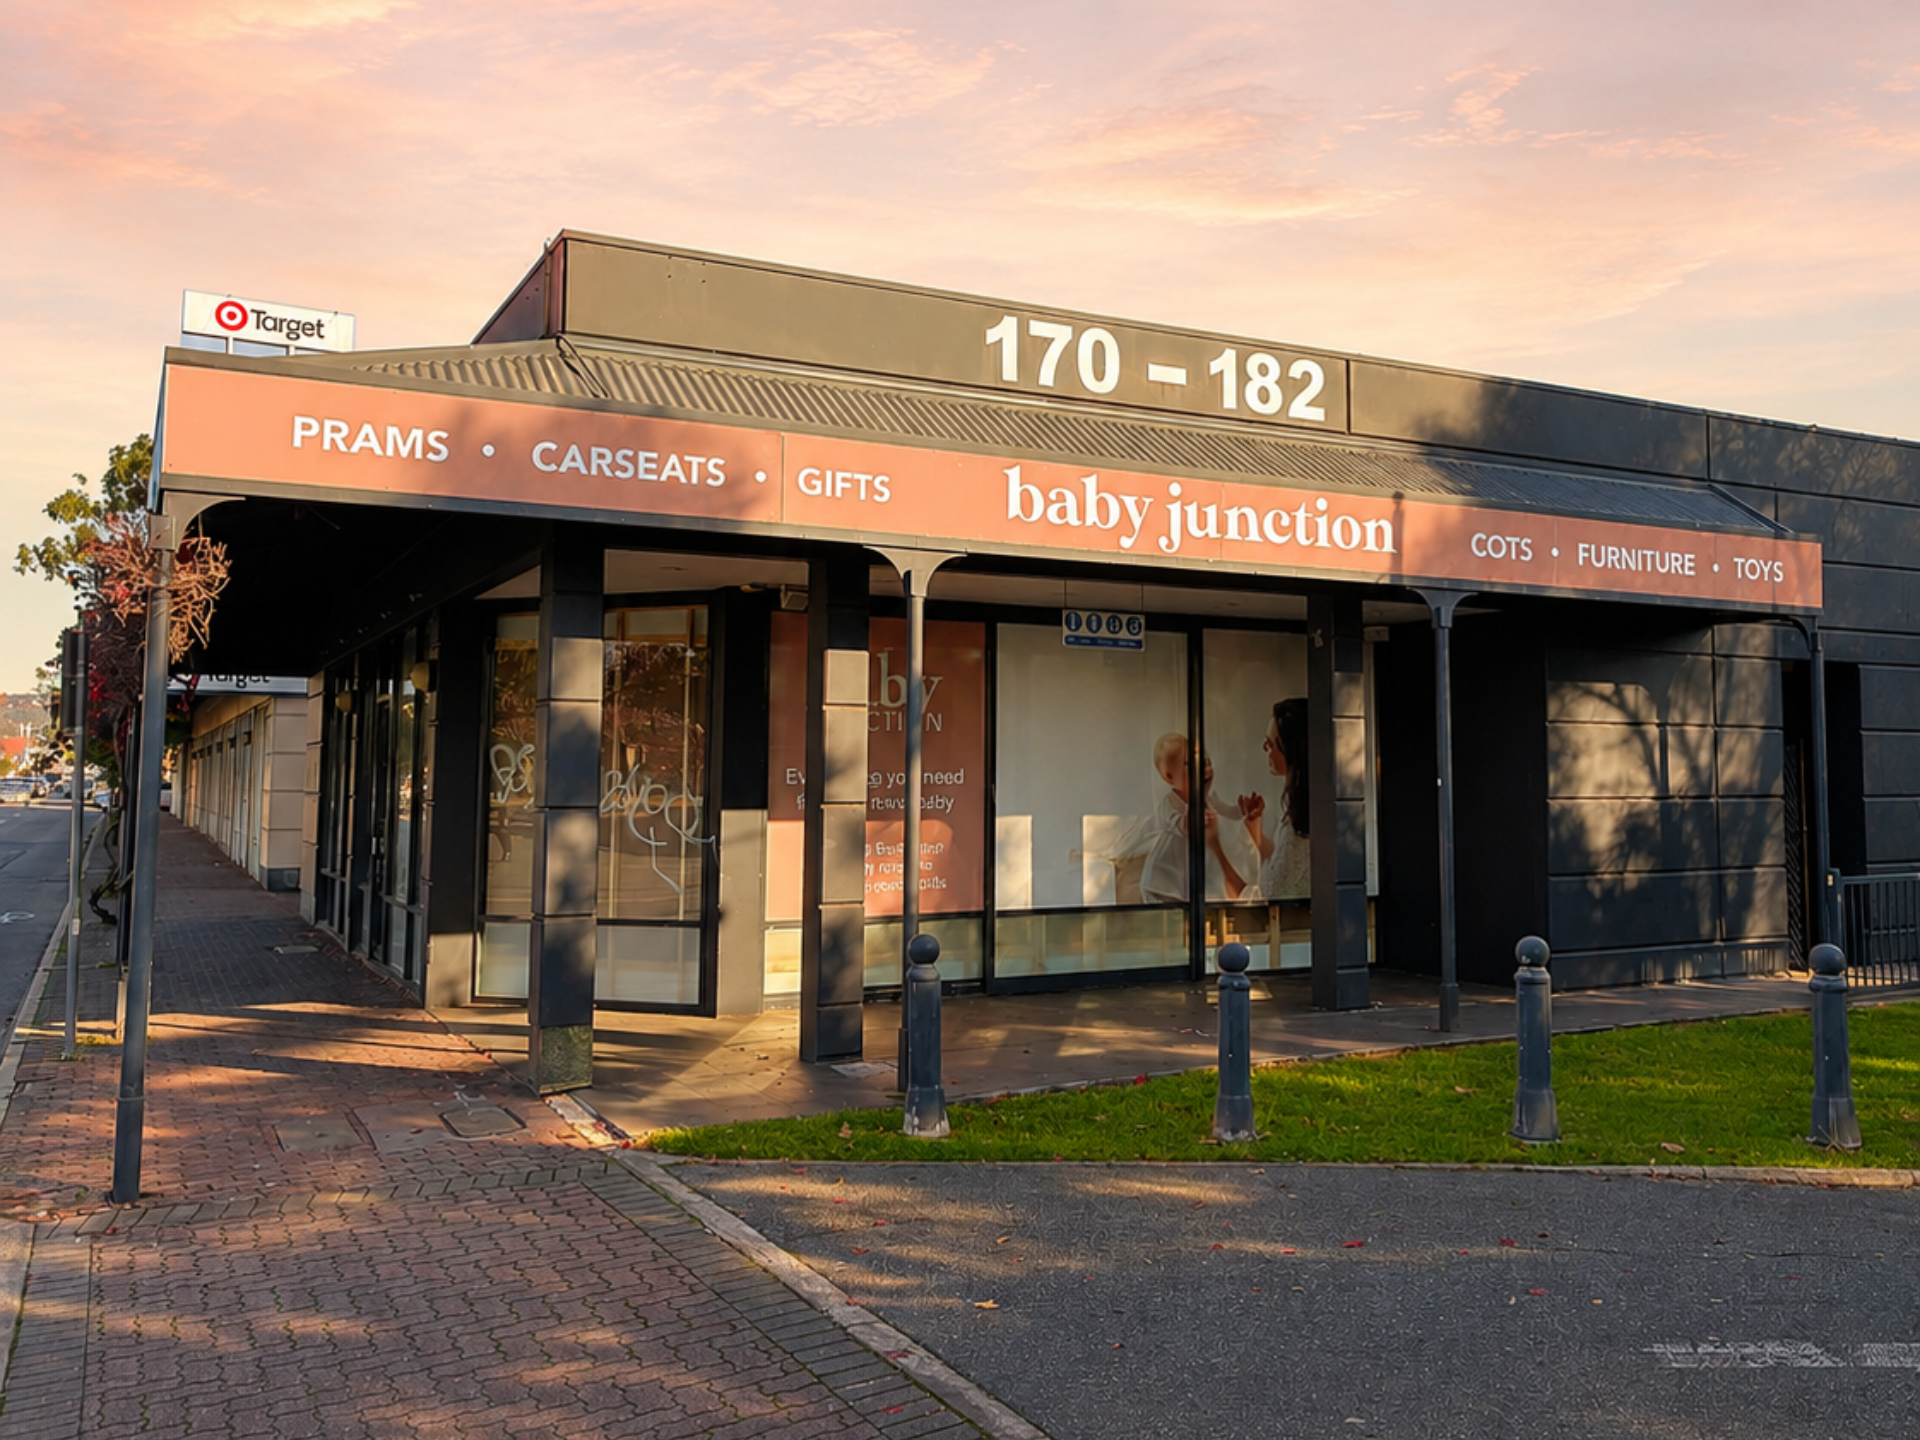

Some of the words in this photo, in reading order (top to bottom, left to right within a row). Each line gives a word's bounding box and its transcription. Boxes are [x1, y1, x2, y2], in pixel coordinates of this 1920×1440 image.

[250, 308, 325, 341] Target
[985, 315, 1120, 394] 170
[1209, 347, 1325, 422] 182
[292, 415, 449, 463] PRAMS
[532, 441, 726, 488] CARSEATS
[797, 467, 891, 503] GIFTS
[1003, 464, 1153, 549] baby
[1158, 482, 1396, 555] junction
[1470, 533, 1532, 562] COTS
[1578, 542, 1695, 576] FURNITURE
[1733, 557, 1784, 583] TOYS
[923, 769, 965, 785] need
